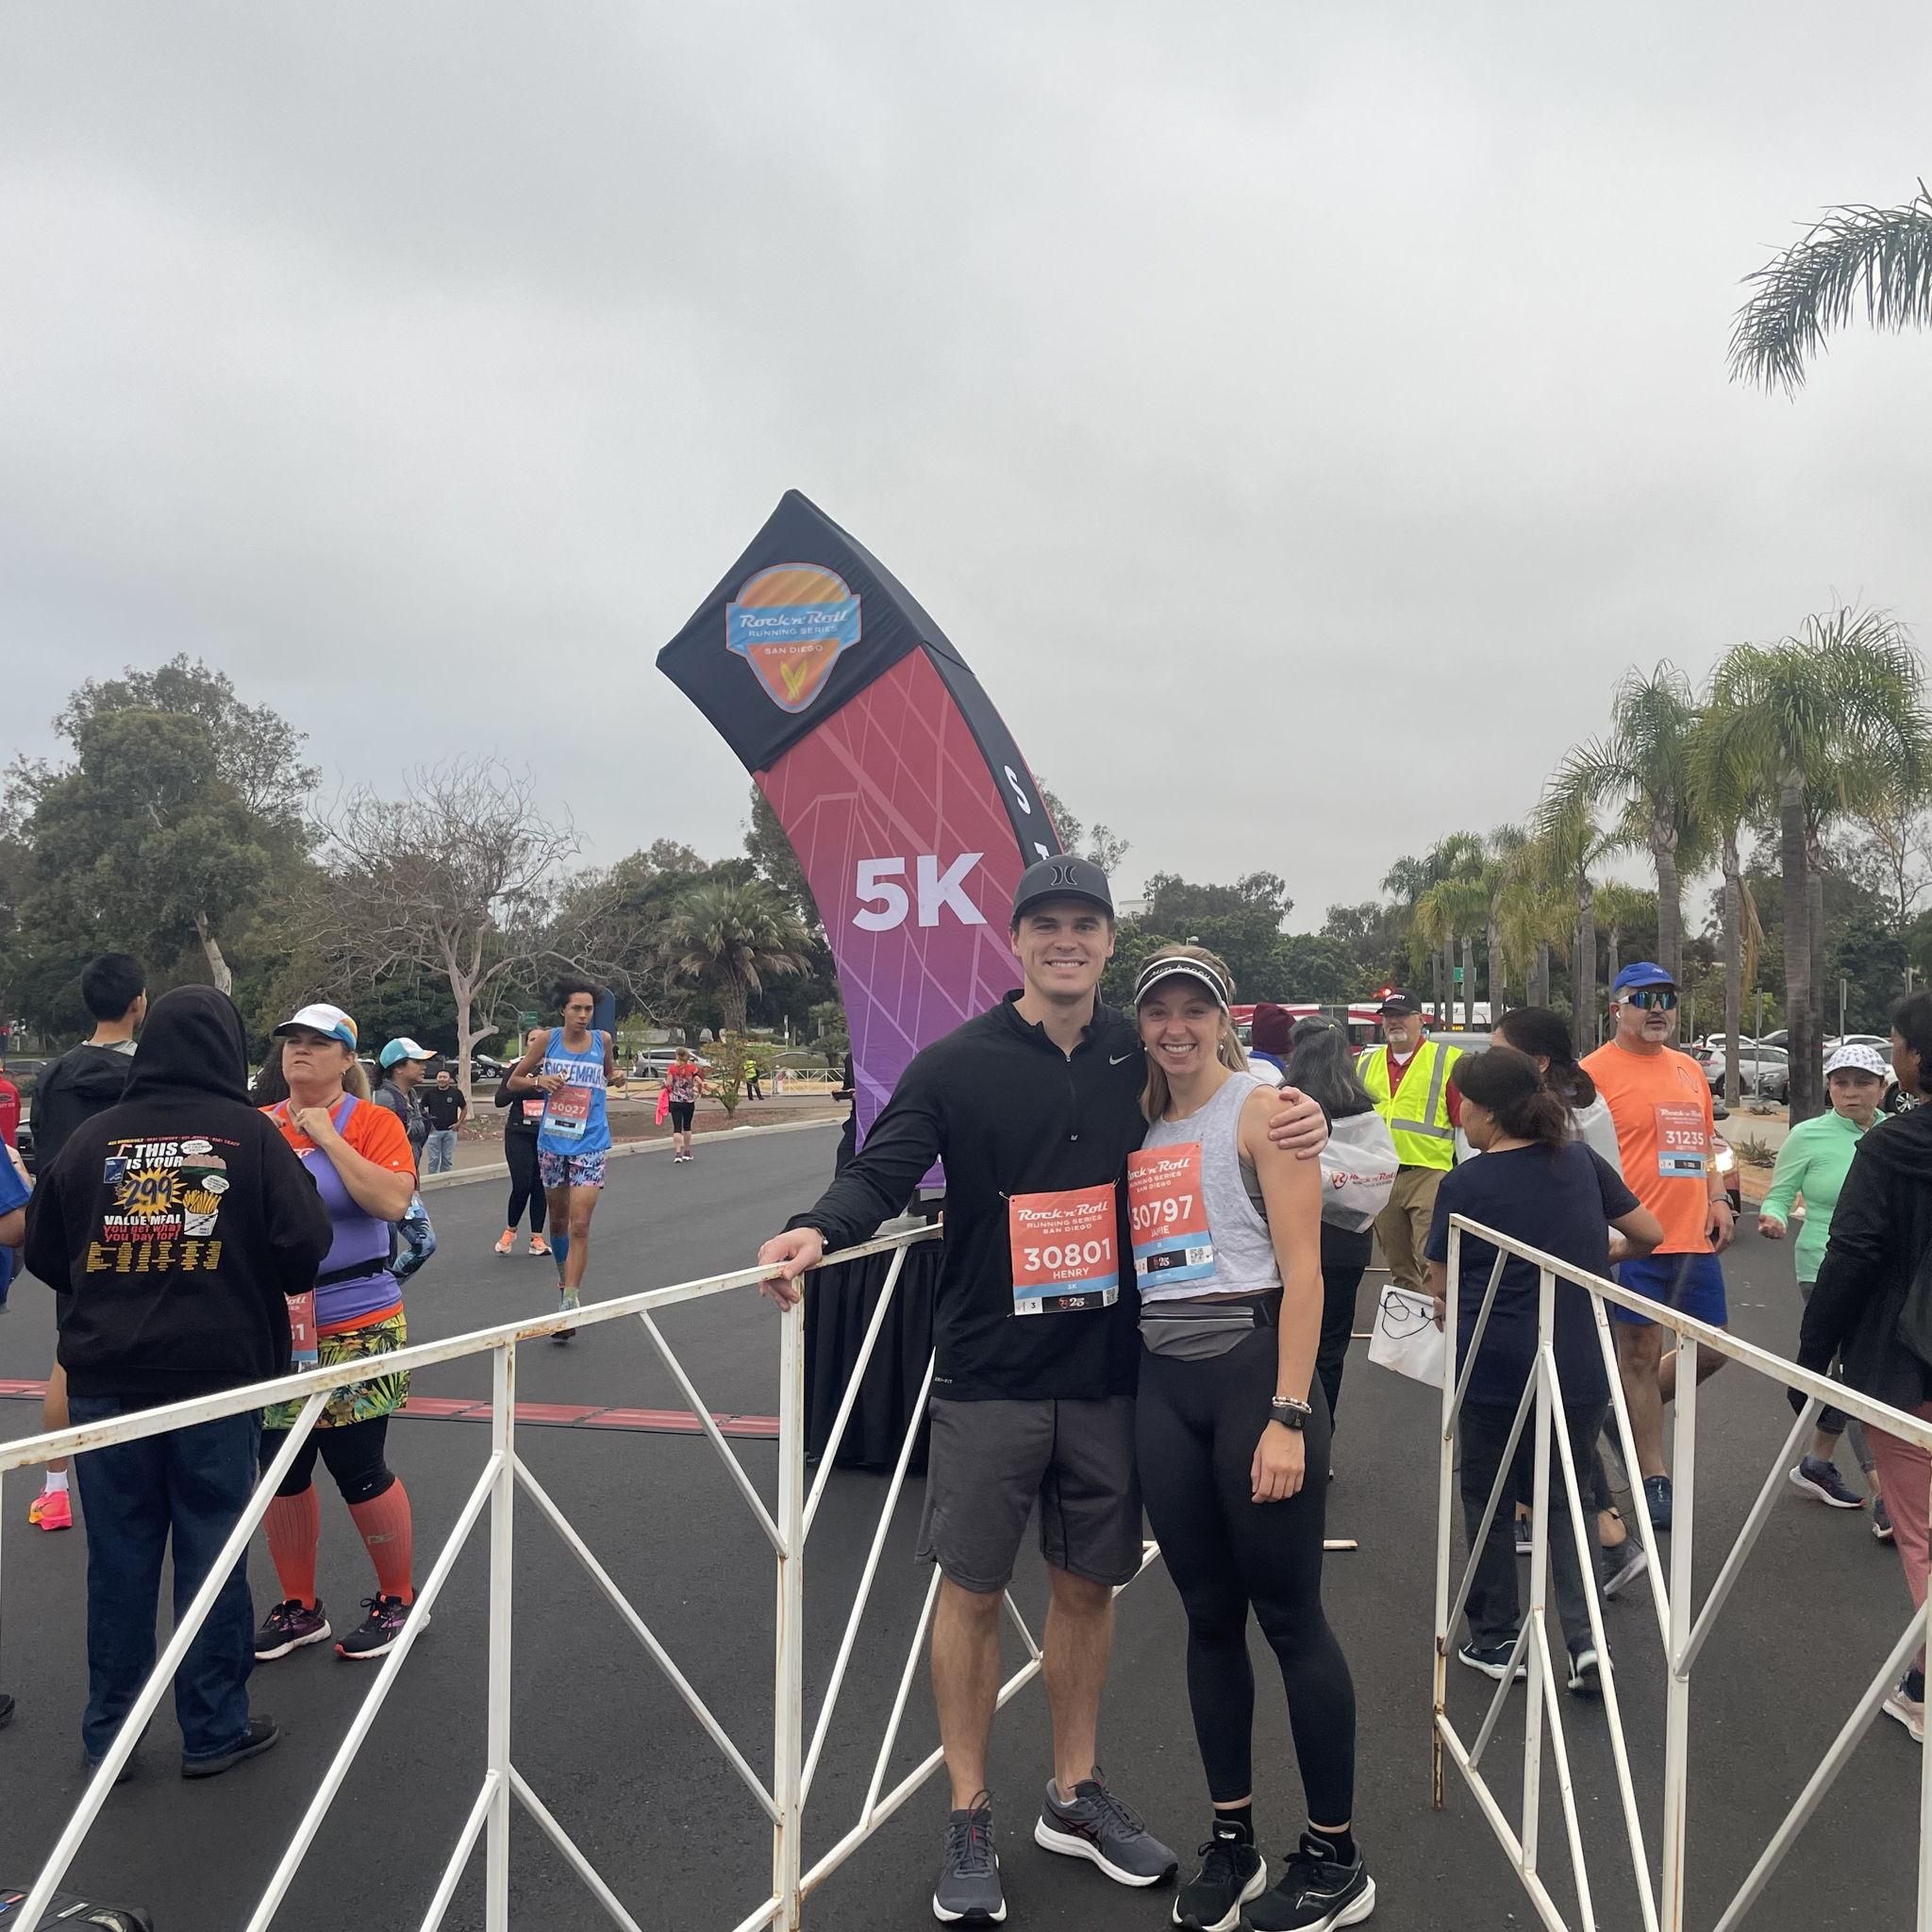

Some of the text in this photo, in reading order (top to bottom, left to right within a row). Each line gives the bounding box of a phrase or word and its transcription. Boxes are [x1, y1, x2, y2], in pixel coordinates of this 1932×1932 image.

[740, 614, 790, 628] Rock
[806, 609, 848, 624] Roll
[748, 625, 838, 638] RUNNING SERIES
[764, 644, 823, 655] SAN DIEGO
[852, 852, 988, 932] 5K
[551, 1102, 586, 1115] 30027
[1665, 1130, 1705, 1146] 31235
[135, 1141, 179, 1158] THIS
[125, 1158, 145, 1170] IS
[145, 1156, 184, 1169] YOUR
[1158, 1158, 1191, 1173] Roll
[1154, 1171, 1182, 1181] SERIES
[1148, 1179, 1172, 1190] DIEGO
[1018, 1208, 1064, 1222] Rock
[1076, 1201, 1108, 1214] Roll
[1132, 1194, 1193, 1231] 30797
[104, 1215, 147, 1225] VALUE
[1026, 1214, 1103, 1229] RUNNING SERIES
[1064, 1223, 1092, 1233] DIEGO
[105, 1233, 129, 1242] you
[132, 1233, 154, 1242] pay
[1024, 1237, 1111, 1272] 30801
[1053, 1267, 1091, 1280] HENRY
[1069, 1297, 1085, 1307] 25
